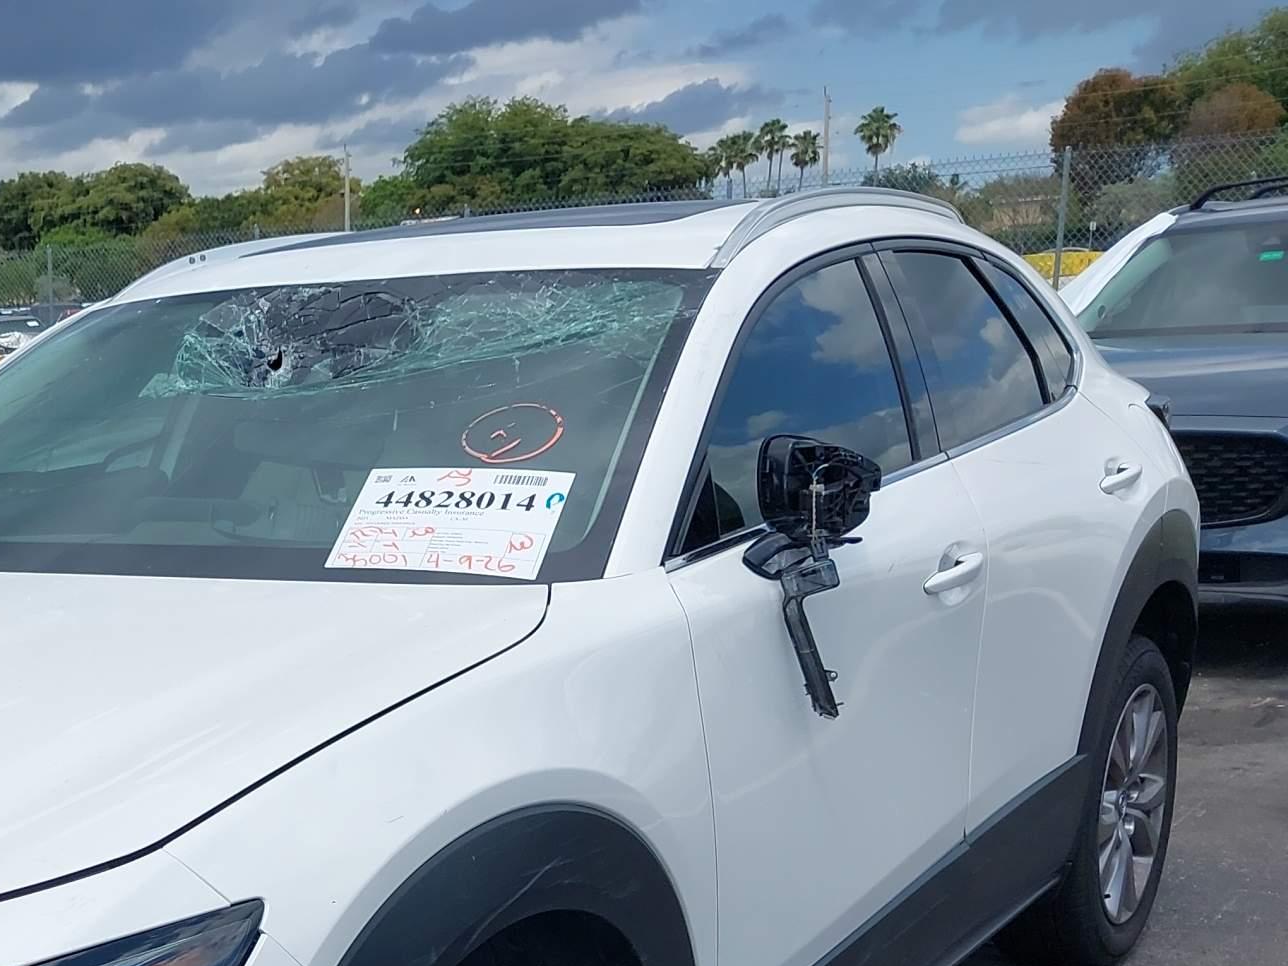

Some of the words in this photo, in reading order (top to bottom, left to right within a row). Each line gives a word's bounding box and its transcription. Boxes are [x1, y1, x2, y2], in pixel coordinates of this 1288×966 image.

[375, 490, 537, 511] 44828014
[358, 508, 406, 517] Progressive
[406, 508, 441, 517] Casualty
[444, 509, 485, 517] Insurance
